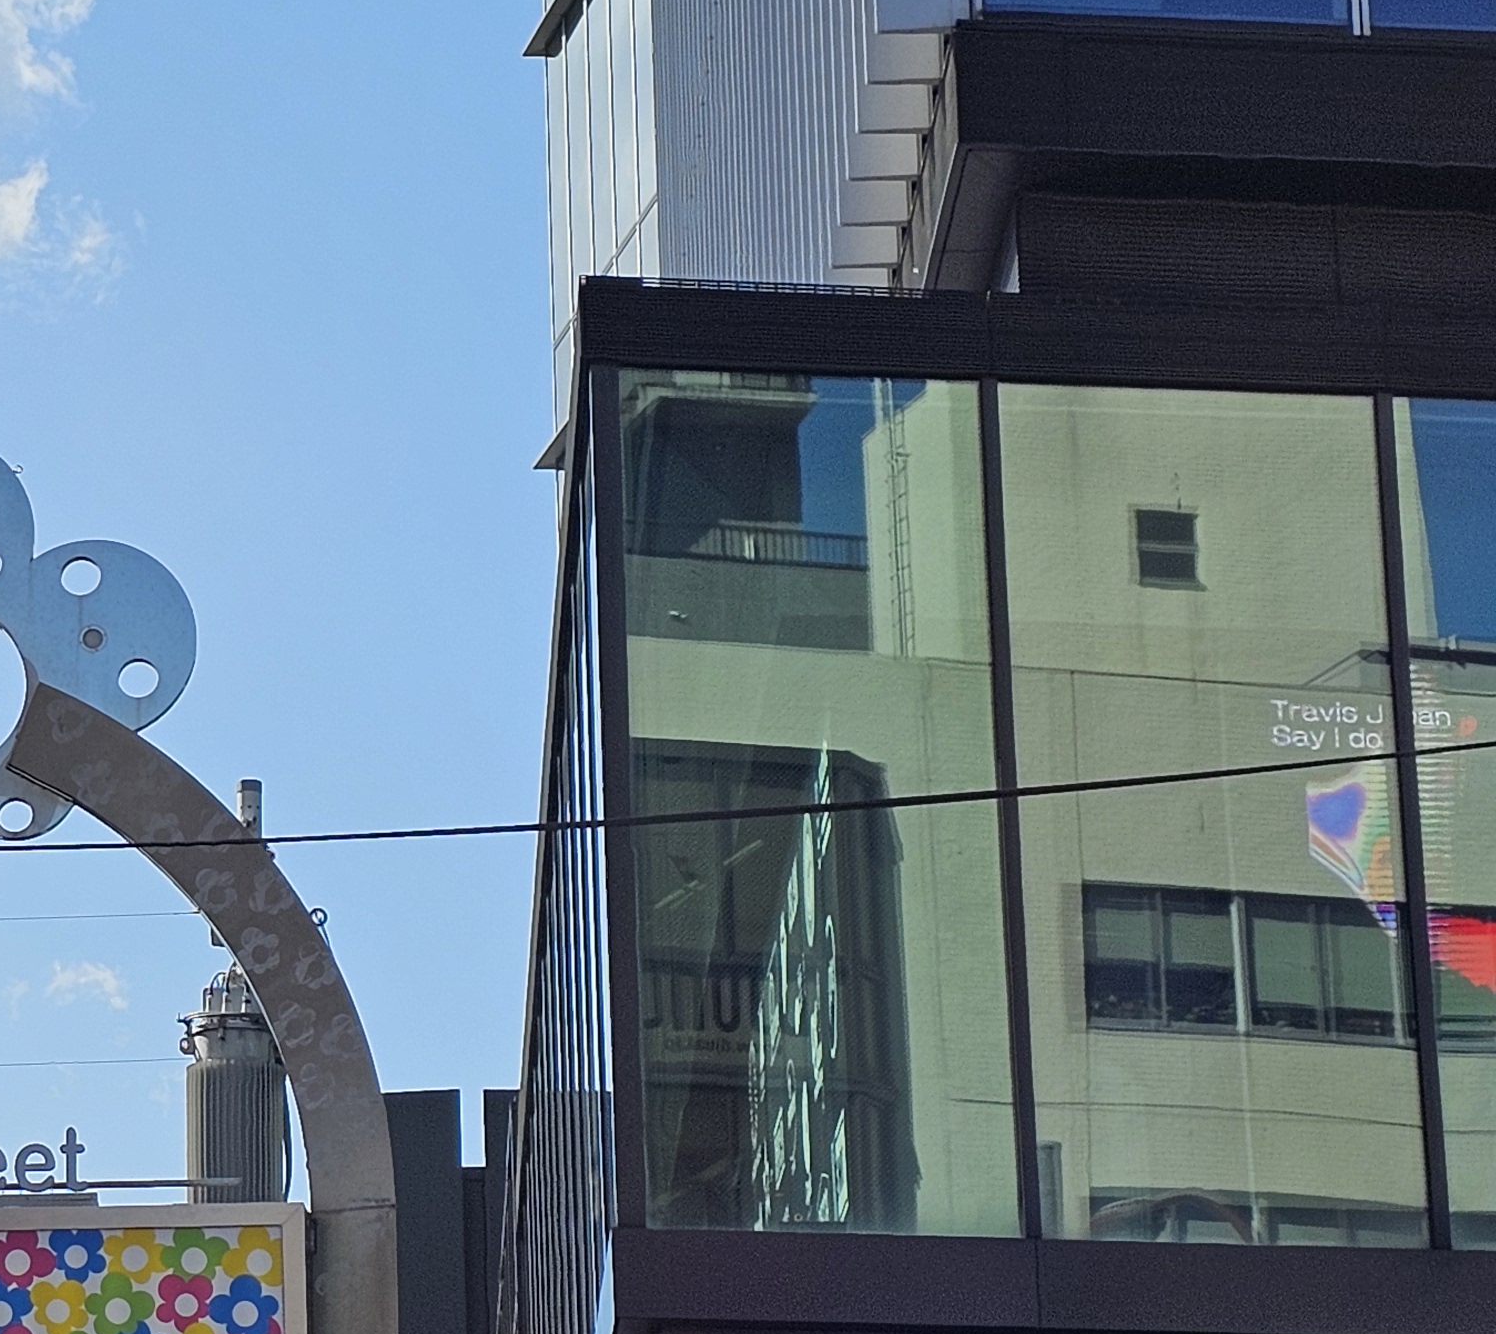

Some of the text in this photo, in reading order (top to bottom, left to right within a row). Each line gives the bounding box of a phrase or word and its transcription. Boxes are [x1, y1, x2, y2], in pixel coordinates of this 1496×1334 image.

[1270, 699, 1451, 726] Travis Jan
[1272, 725, 1325, 750] Say
[1349, 727, 1382, 749] do
